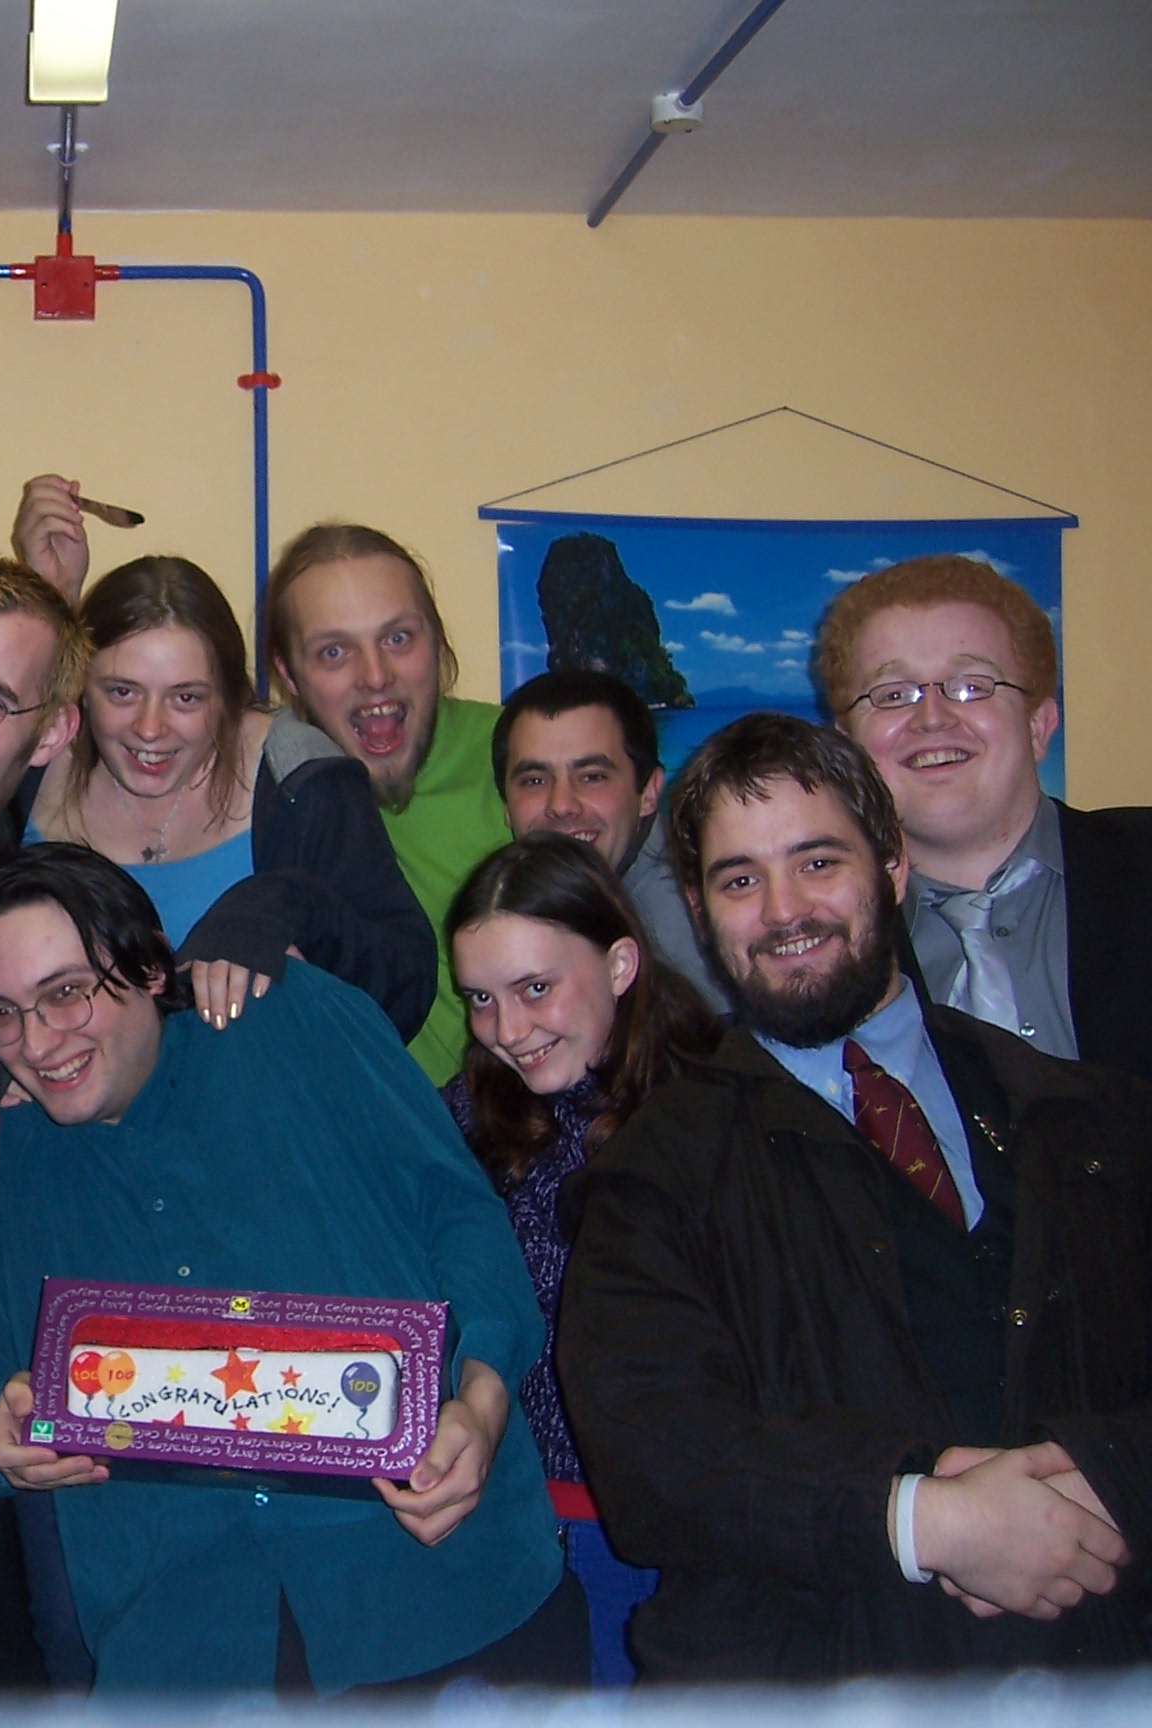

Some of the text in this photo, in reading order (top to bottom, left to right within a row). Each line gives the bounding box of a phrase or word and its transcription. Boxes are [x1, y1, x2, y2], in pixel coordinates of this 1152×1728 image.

[176, 1293, 231, 1305] Celebrat
[137, 1302, 209, 1316] Celebration
[286, 1300, 321, 1314] Party
[324, 1303, 399, 1318] Celebration
[402, 1308, 431, 1328] Cake
[285, 1312, 361, 1327] Celebration
[363, 1317, 394, 1328] Cake
[398, 1320, 422, 1349] Party
[106, 1368, 135, 1382] 100
[347, 1379, 378, 1393] 100
[414, 1352, 427, 1422] Celebration
[118, 1385, 342, 1418] CONGRATULATIONS!
[164, 1428, 198, 1445] Party
[202, 1434, 234, 1446] Cake
[237, 1436, 313, 1452] Celebration
[414, 1425, 428, 1456] Cake
[146, 1440, 222, 1457] Celebration
[226, 1446, 261, 1461] Party
[316, 1440, 352, 1455] Party
[355, 1446, 389, 1458] Cake
[264, 1452, 296, 1463] Cake
[299, 1454, 375, 1470] Celebration
[379, 1455, 416, 1471] Party
